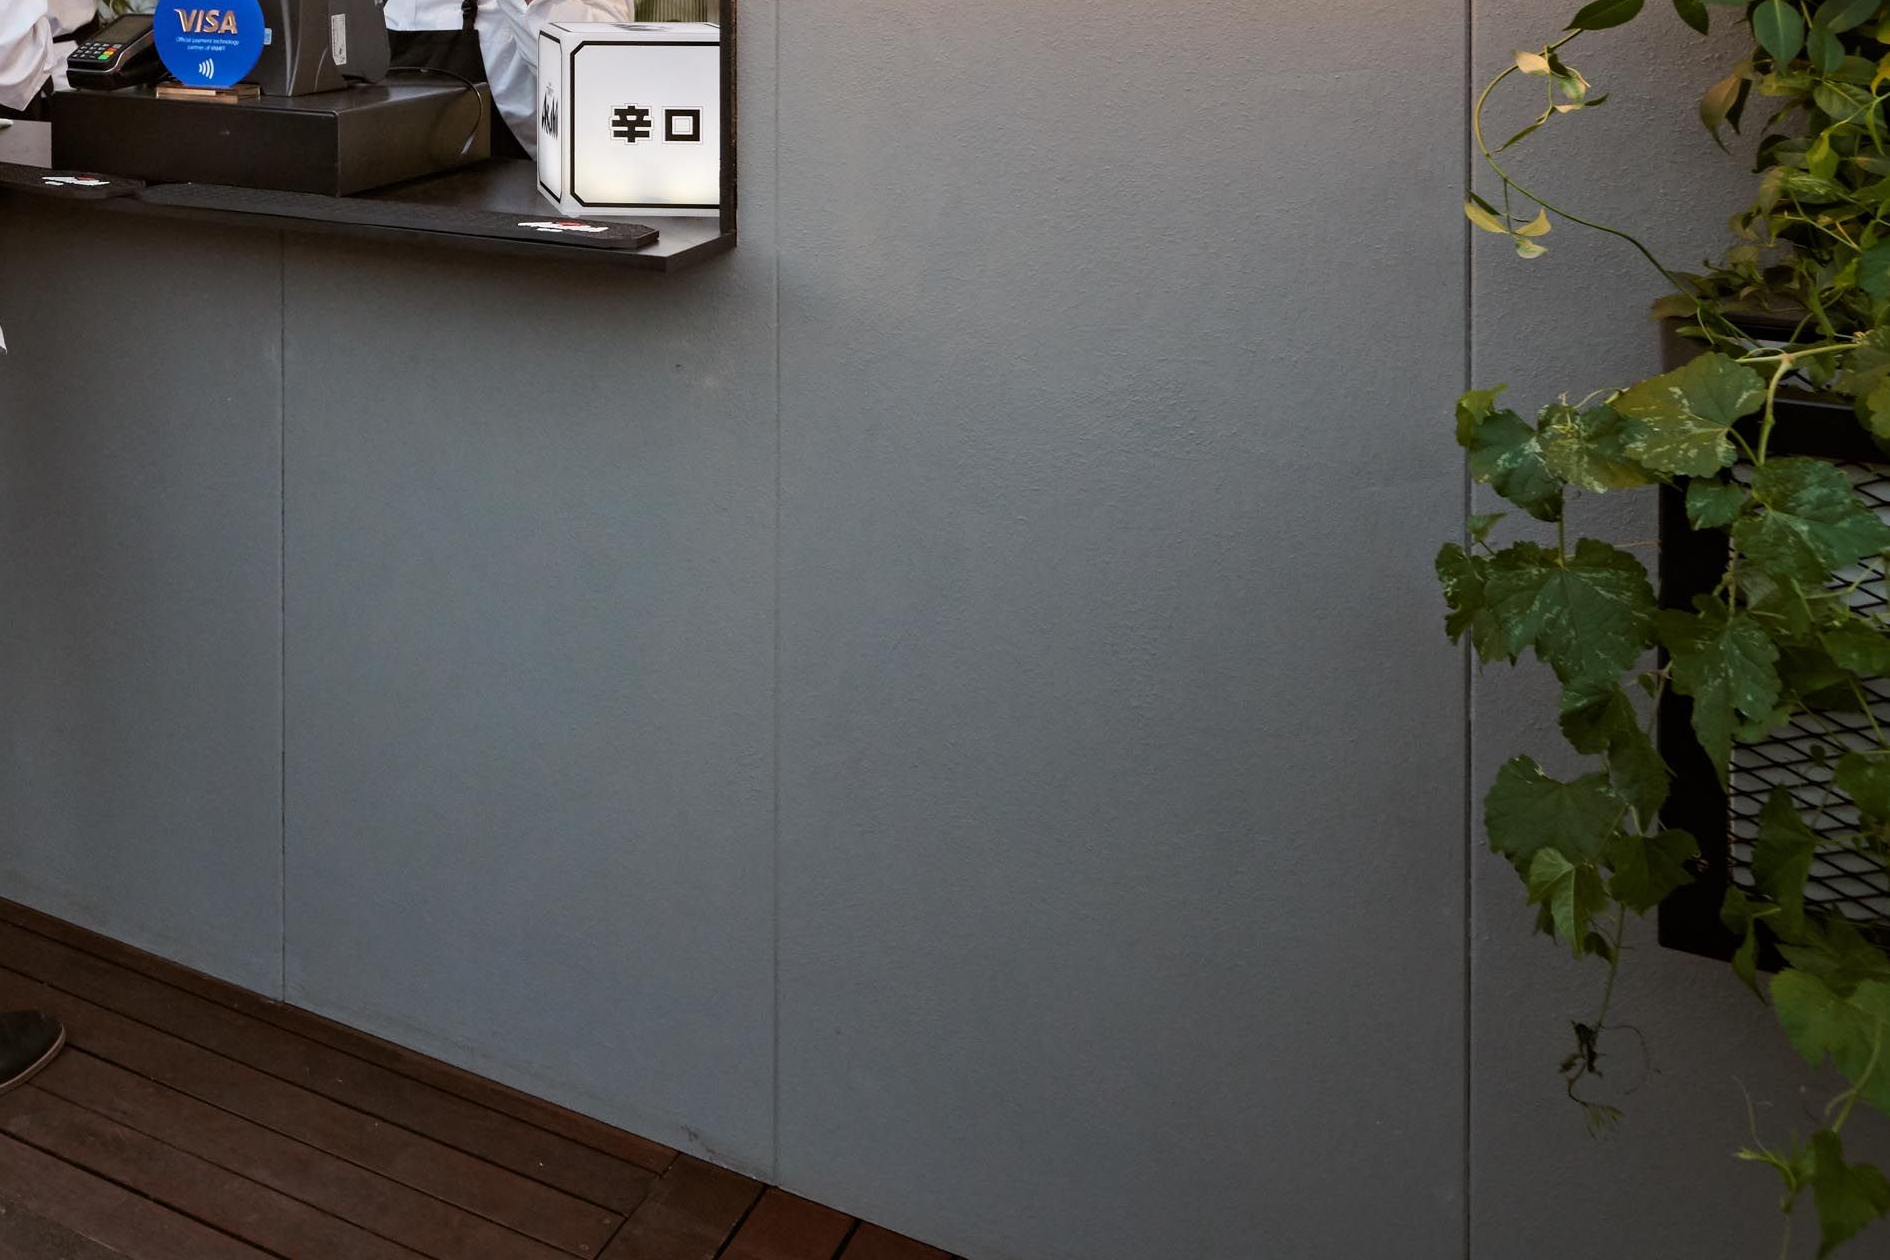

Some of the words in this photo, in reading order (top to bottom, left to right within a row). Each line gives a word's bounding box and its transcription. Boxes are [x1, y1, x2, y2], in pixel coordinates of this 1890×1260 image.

[174, 8, 238, 34] VISA
[213, 38, 240, 46] technology
[611, 105, 701, 143] 辛口
